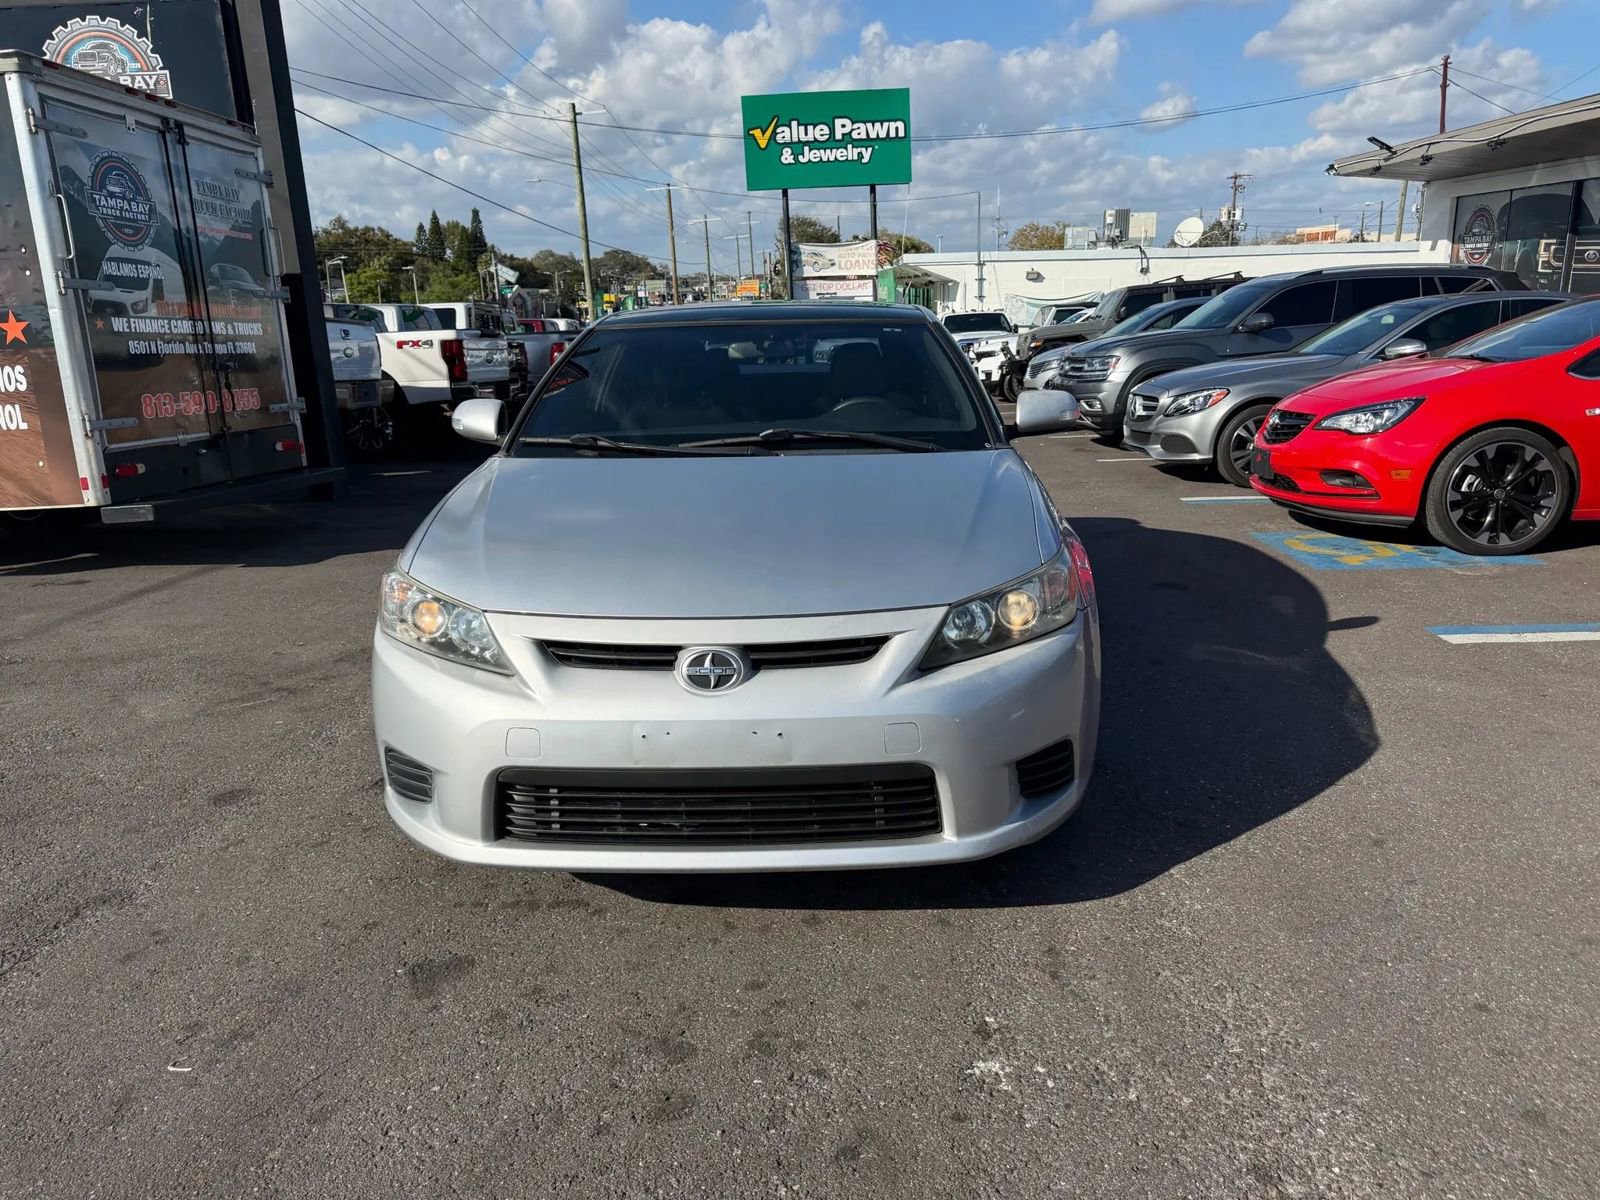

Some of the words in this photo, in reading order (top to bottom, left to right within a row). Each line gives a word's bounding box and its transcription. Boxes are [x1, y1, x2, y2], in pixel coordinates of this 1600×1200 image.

[749, 117, 830, 149] Value
[834, 118, 905, 140] Pawn
[780, 147, 795, 164] &
[798, 144, 873, 163] Jewelry
[93, 194, 131, 211] TAMPA
[130, 201, 150, 214] BAY
[102, 260, 138, 277] HABLAMOS
[136, 263, 165, 280] ESPAÑOL
[111, 317, 130, 332] WE
[130, 318, 171, 334] FINANCE
[226, 323, 234, 335] &
[233, 322, 263, 336] TRUCKS
[149, 340, 157, 354] N
[156, 340, 184, 355] Florida
[397, 339, 433, 350] FX4
